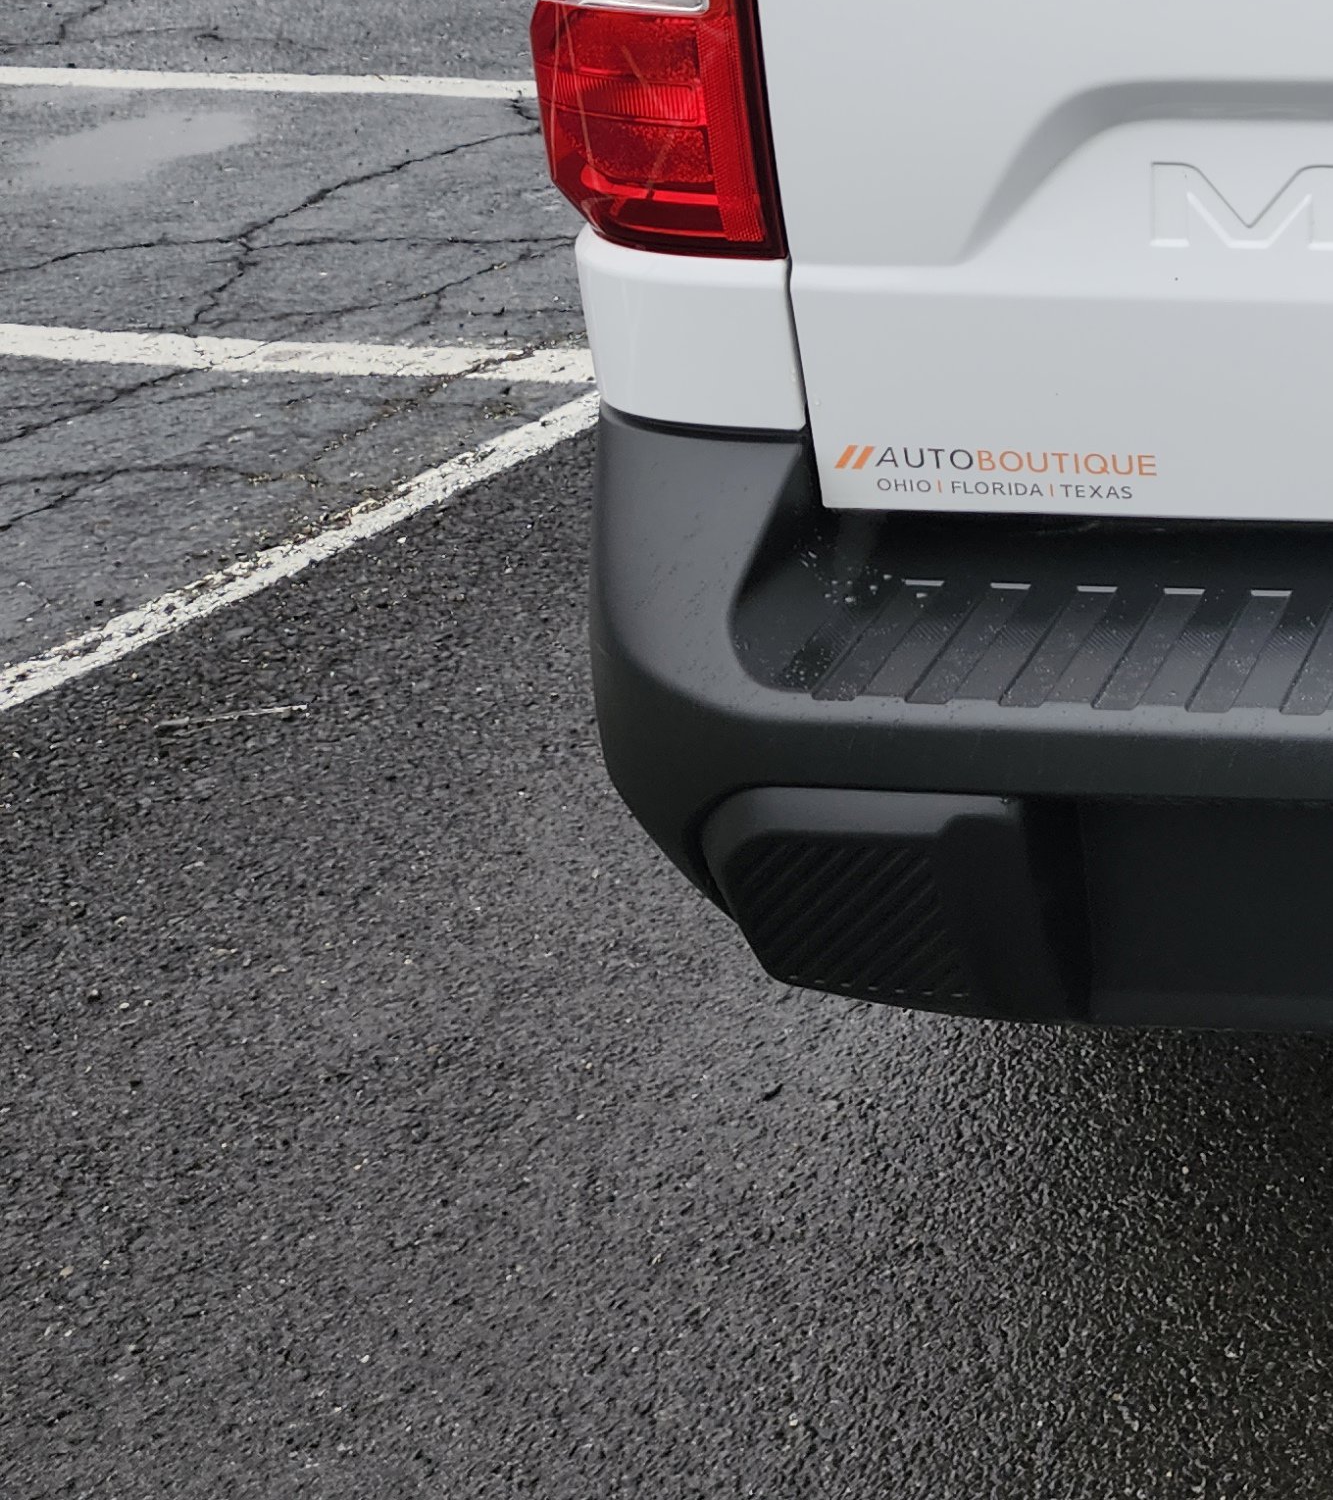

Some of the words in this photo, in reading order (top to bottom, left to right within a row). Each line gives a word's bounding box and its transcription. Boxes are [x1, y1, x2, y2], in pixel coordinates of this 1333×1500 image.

[874, 445, 1158, 477] AUTOBOUTIQUE
[876, 477, 932, 493] OHIO
[950, 480, 1044, 497] FLORIDA
[1060, 483, 1133, 500] TEXAS
